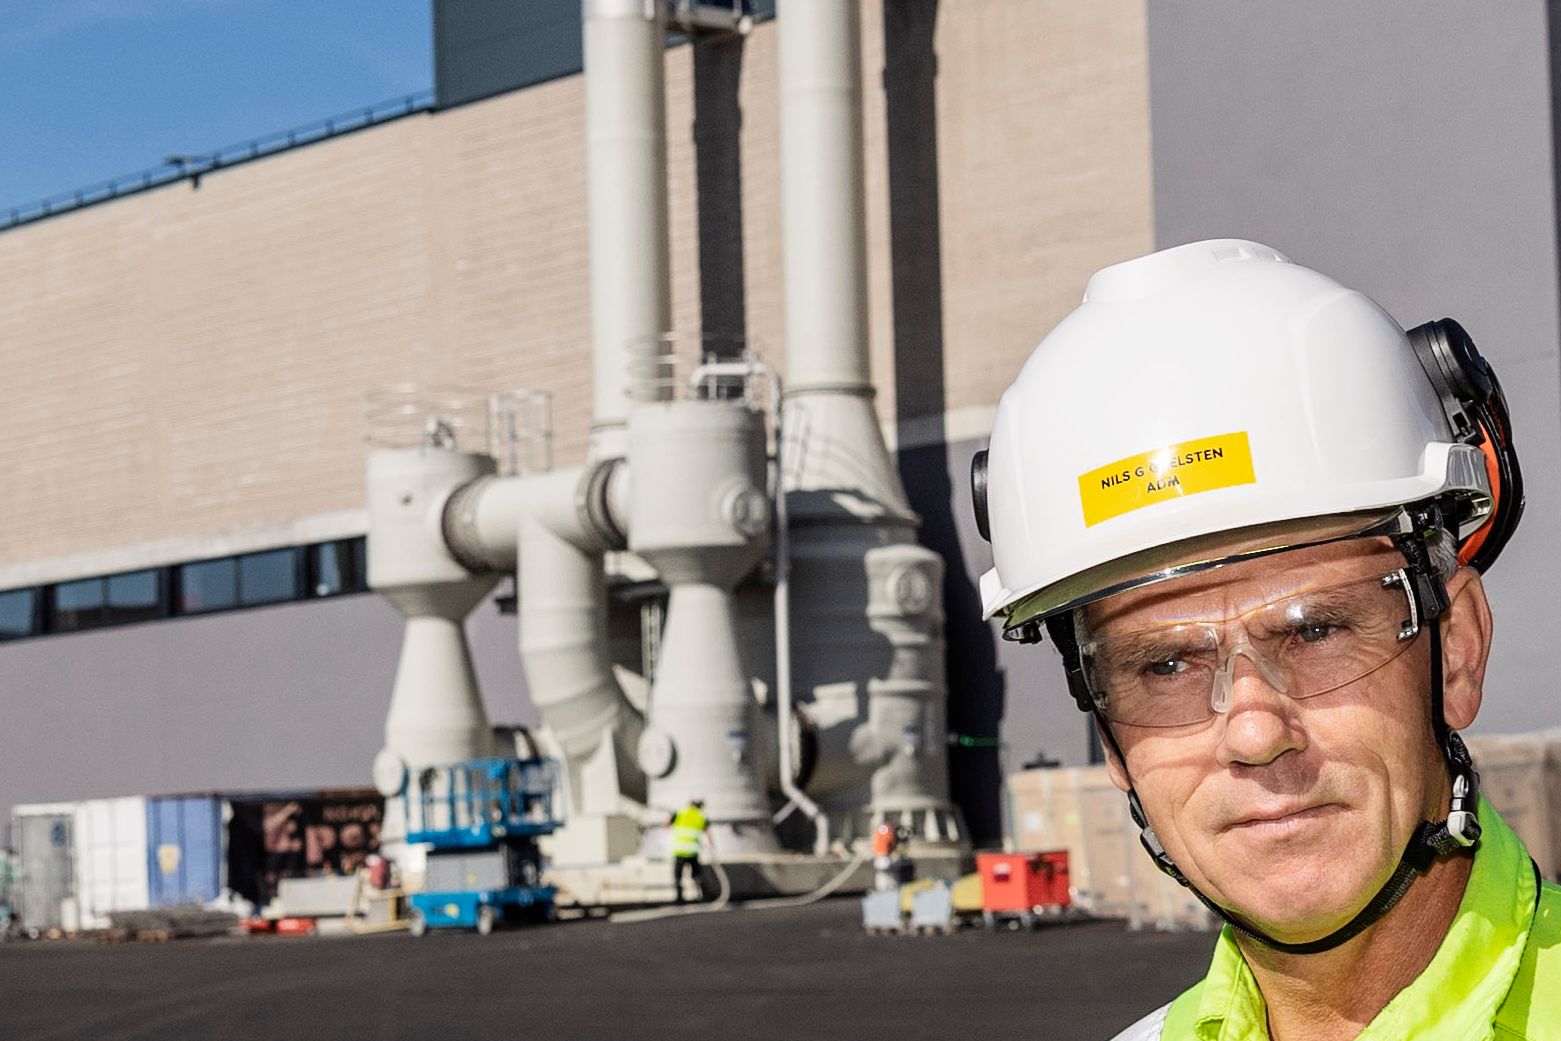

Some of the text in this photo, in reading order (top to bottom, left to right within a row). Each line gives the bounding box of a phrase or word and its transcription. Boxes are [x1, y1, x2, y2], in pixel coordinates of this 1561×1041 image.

[1101, 448, 1223, 489] NILS G GELSTEN
[1146, 475, 1180, 493] ADM
